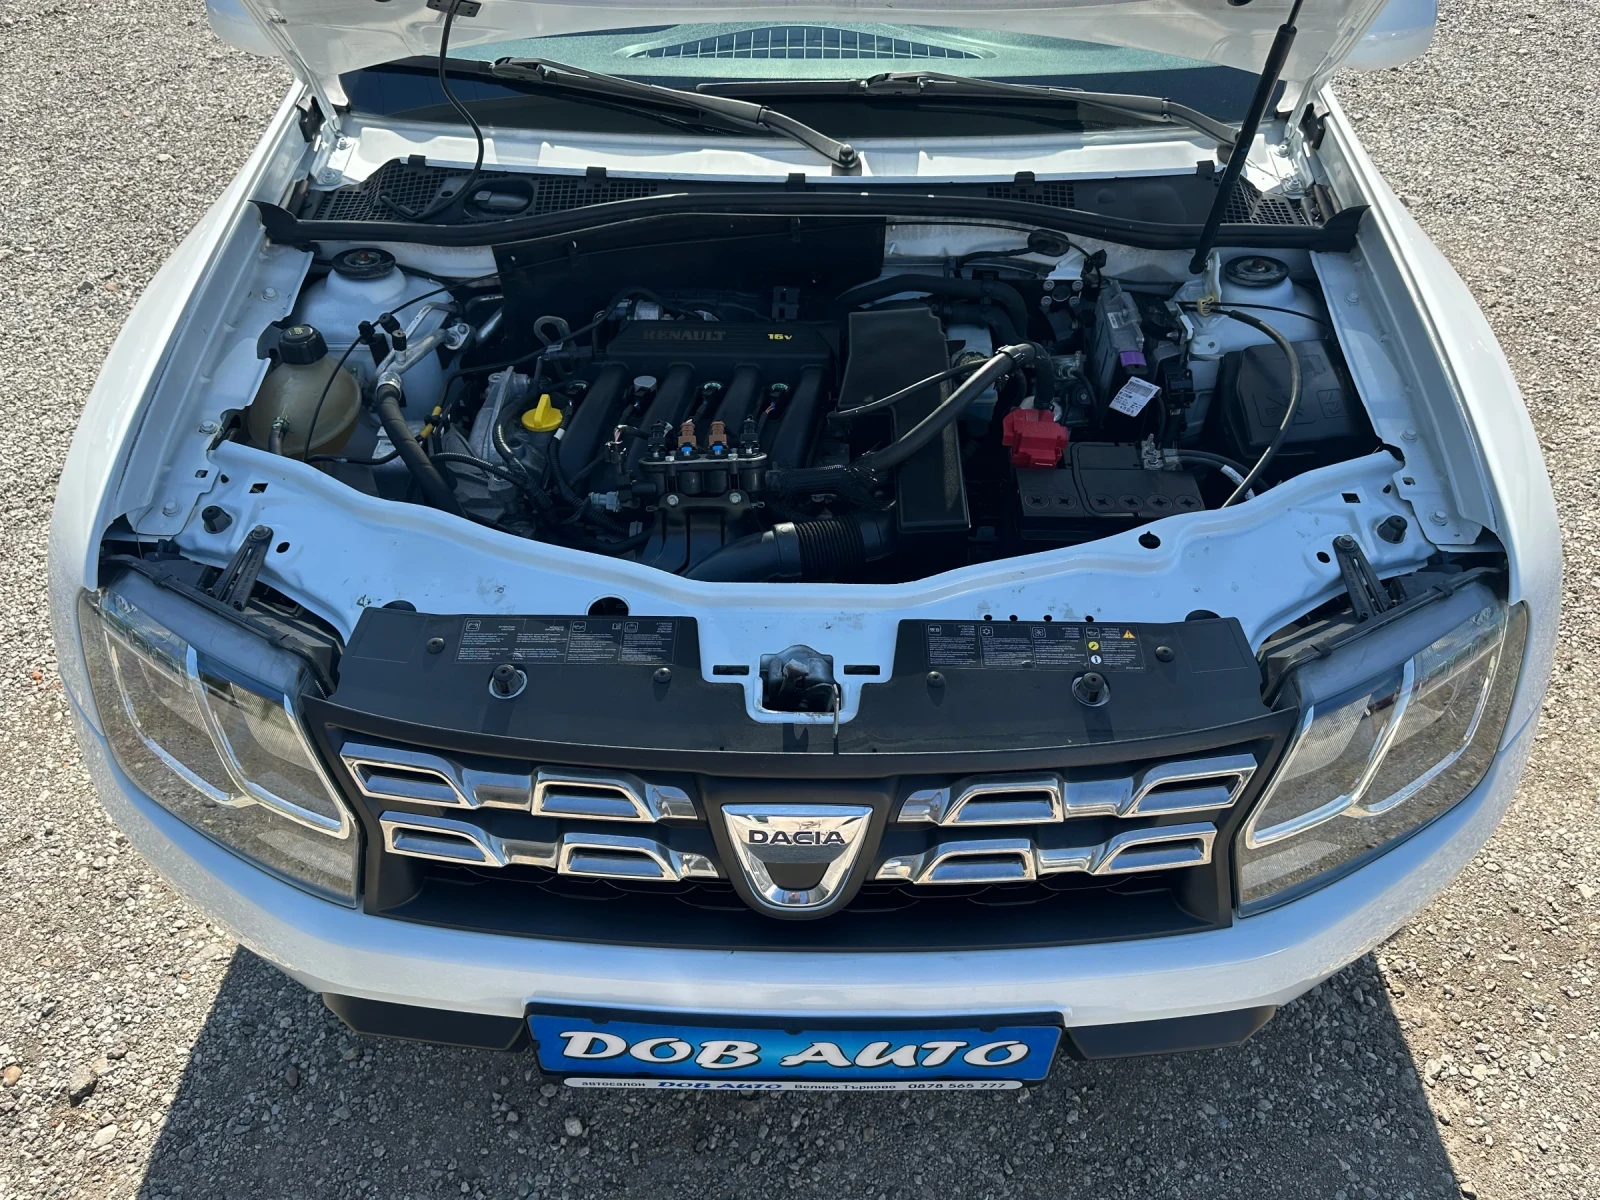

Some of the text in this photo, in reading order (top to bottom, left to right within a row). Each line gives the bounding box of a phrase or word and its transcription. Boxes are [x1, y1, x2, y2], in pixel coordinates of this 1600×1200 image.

[642, 330, 726, 341] RENAULT
[748, 829, 846, 845] DACIA
[558, 1030, 1031, 1070] DOB AUTO
[581, 1080, 646, 1088] автосалон
[656, 1081, 711, 1090] DOB
[716, 1082, 782, 1090] AUTO
[843, 1083, 896, 1091] Търново
[948, 1082, 975, 1090] 565
